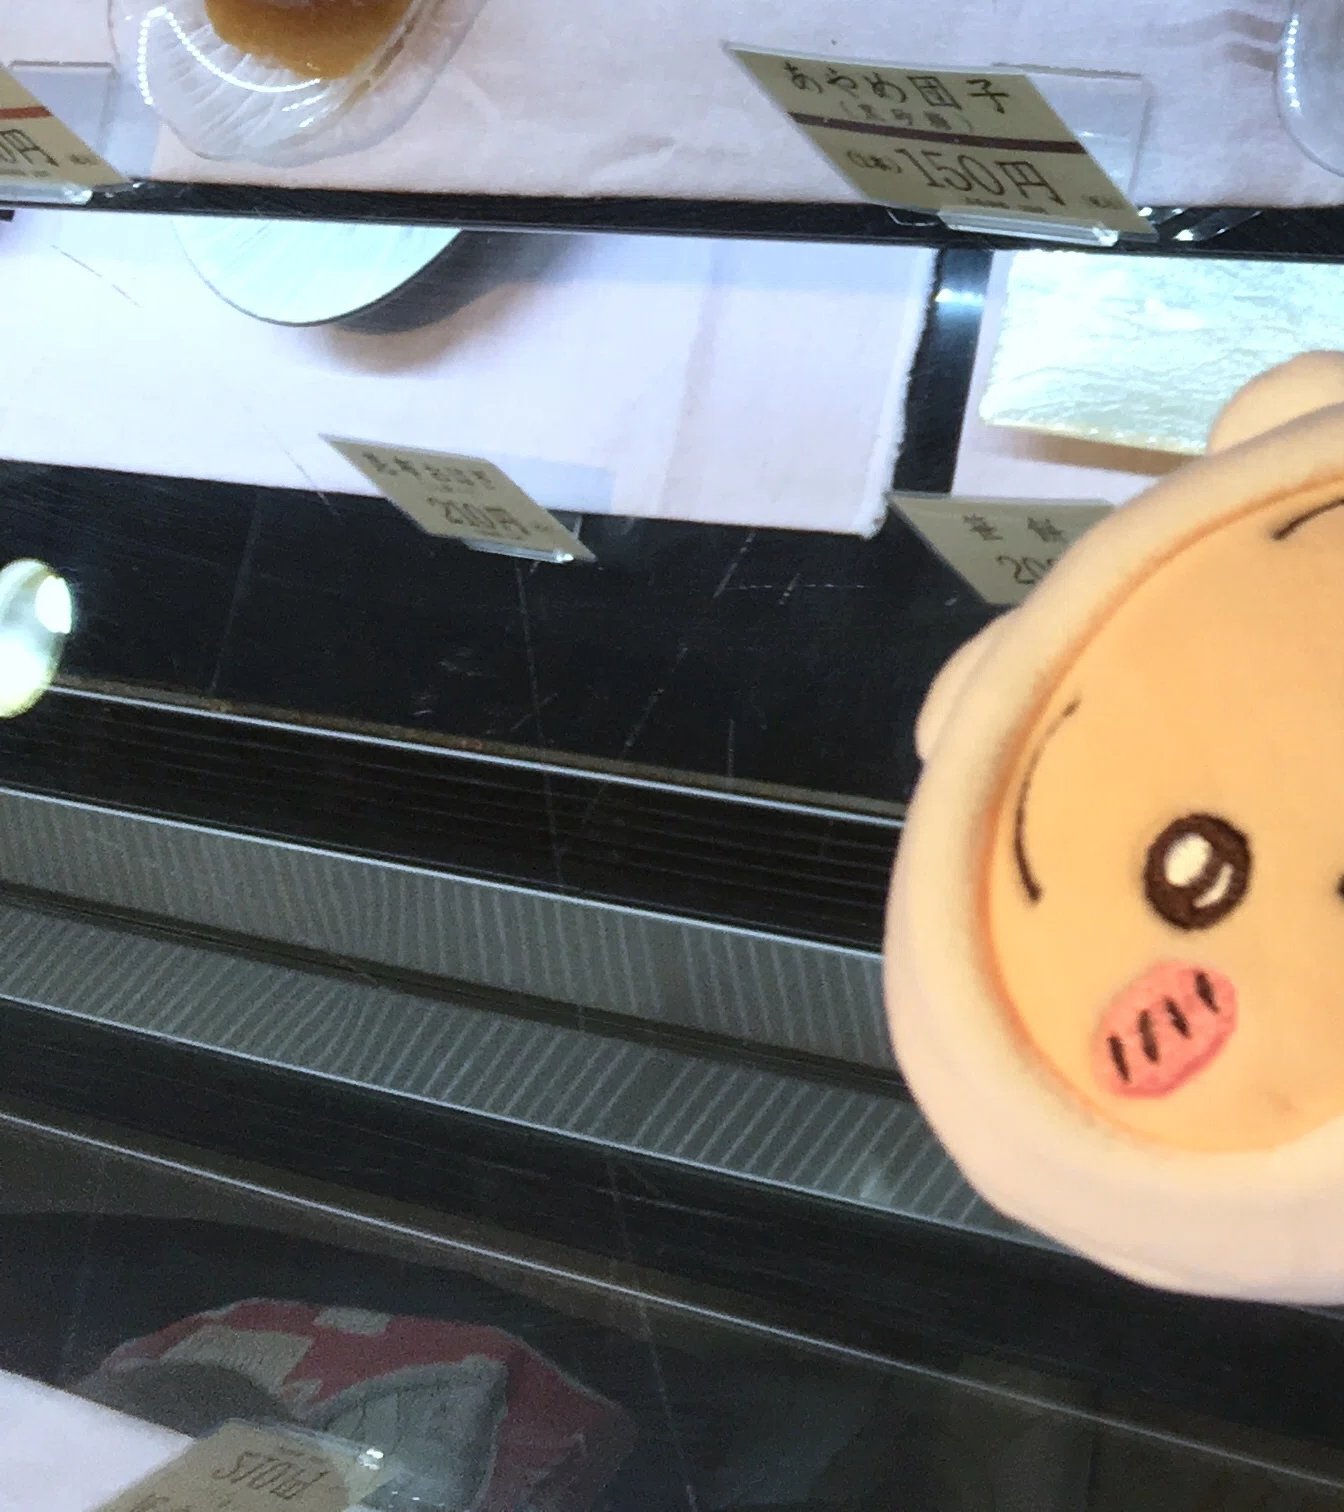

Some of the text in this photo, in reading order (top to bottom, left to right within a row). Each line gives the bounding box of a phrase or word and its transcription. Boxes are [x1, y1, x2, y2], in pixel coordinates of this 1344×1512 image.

[783, 61, 1010, 115] あやめ団子
[895, 148, 1067, 207] 150円
[996, 555, 1055, 584] 20
